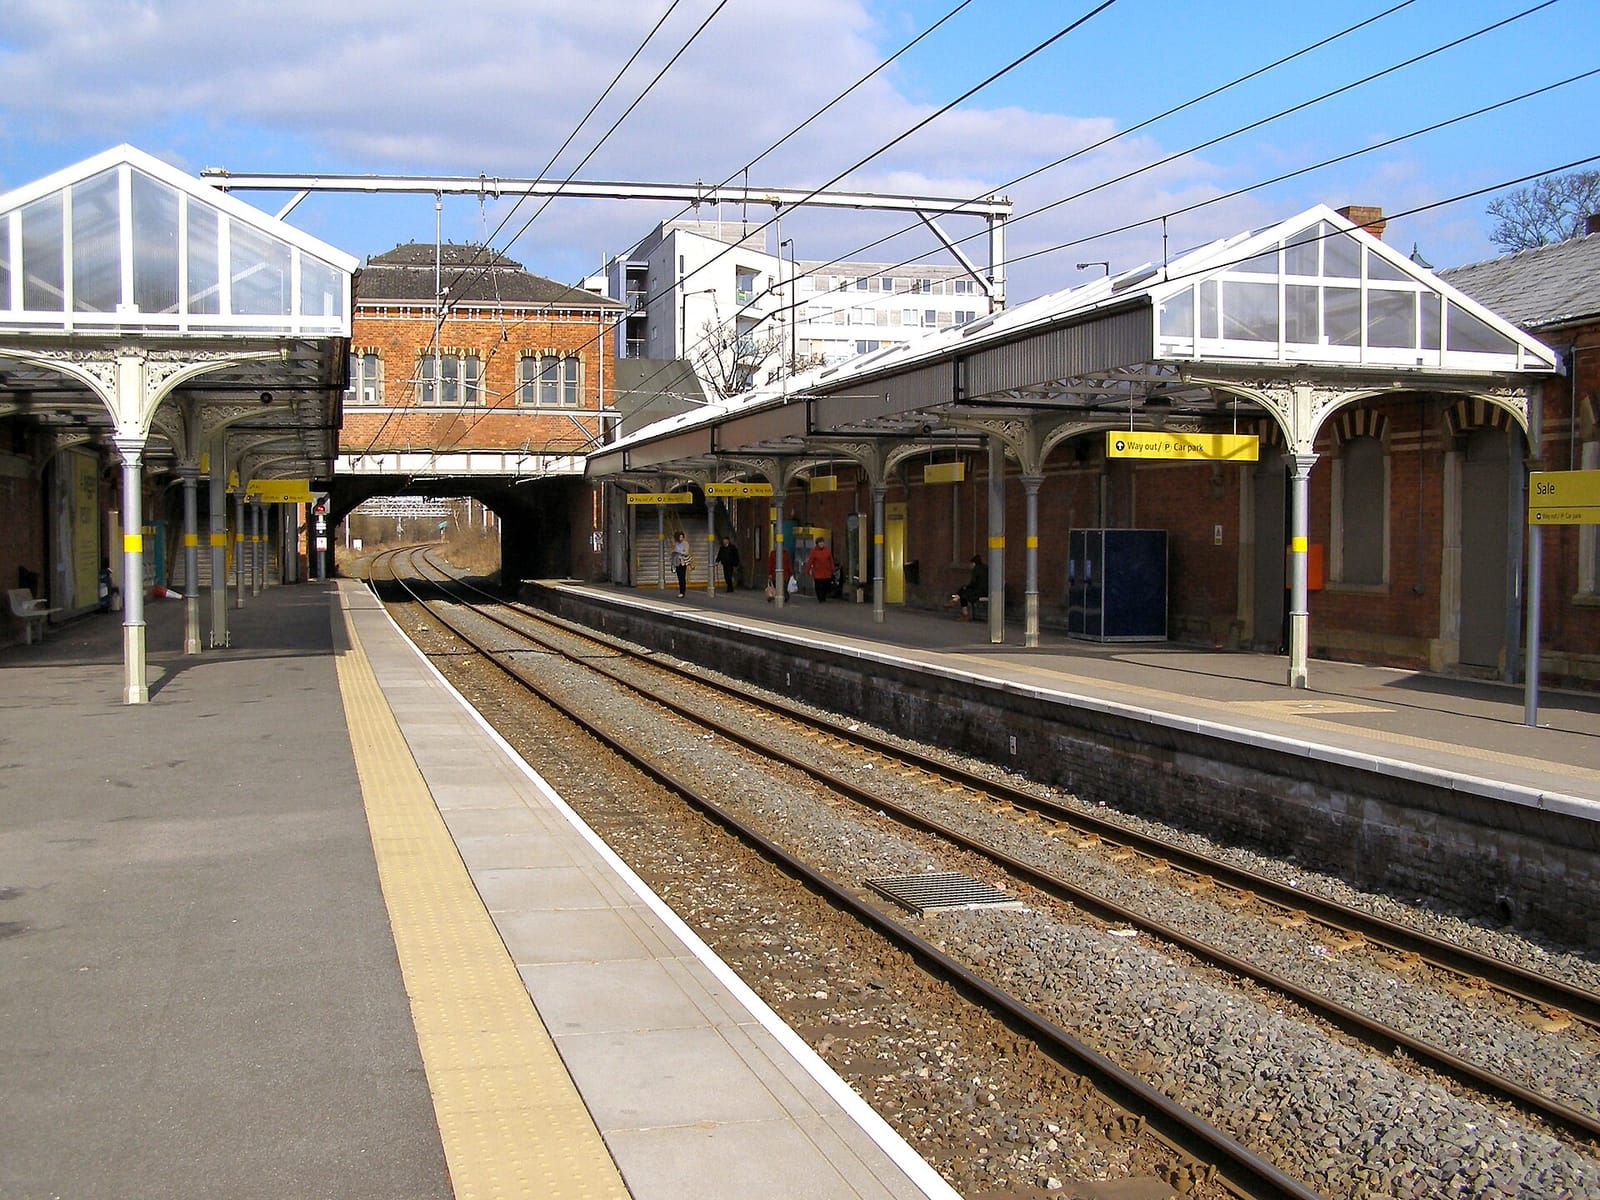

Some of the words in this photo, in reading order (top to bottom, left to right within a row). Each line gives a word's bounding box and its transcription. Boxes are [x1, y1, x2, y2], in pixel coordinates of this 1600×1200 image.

[1127, 441, 1143, 453] Way
[1173, 442, 1186, 451] Car
[1188, 443, 1204, 453] park
[1536, 482, 1555, 495] Sale
